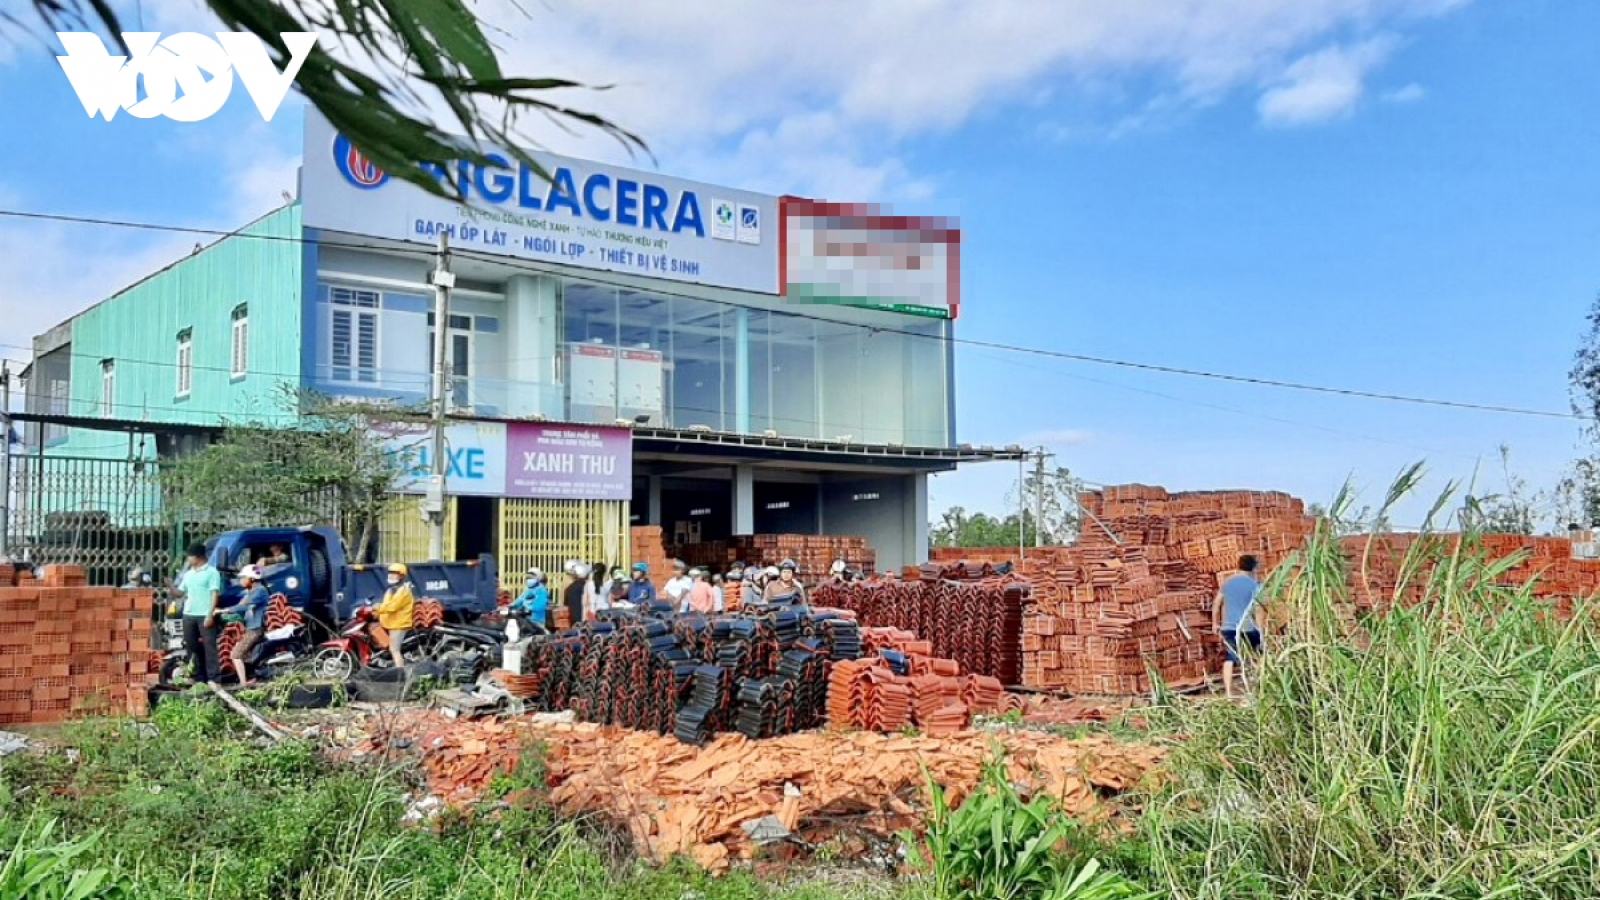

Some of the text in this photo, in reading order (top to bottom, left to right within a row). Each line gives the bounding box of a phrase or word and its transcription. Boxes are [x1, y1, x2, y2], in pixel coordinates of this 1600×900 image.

[415, 218, 456, 240] GẠCH
[459, 219, 479, 241] ỐP
[483, 227, 507, 246] LÁT
[523, 235, 556, 254] NGÓI
[561, 242, 585, 260] LỢP
[600, 247, 633, 265] THIẾT
[638, 256, 649, 270] BỊ
[671, 259, 700, 276] SINH
[523, 451, 616, 475] XANH THƯ
